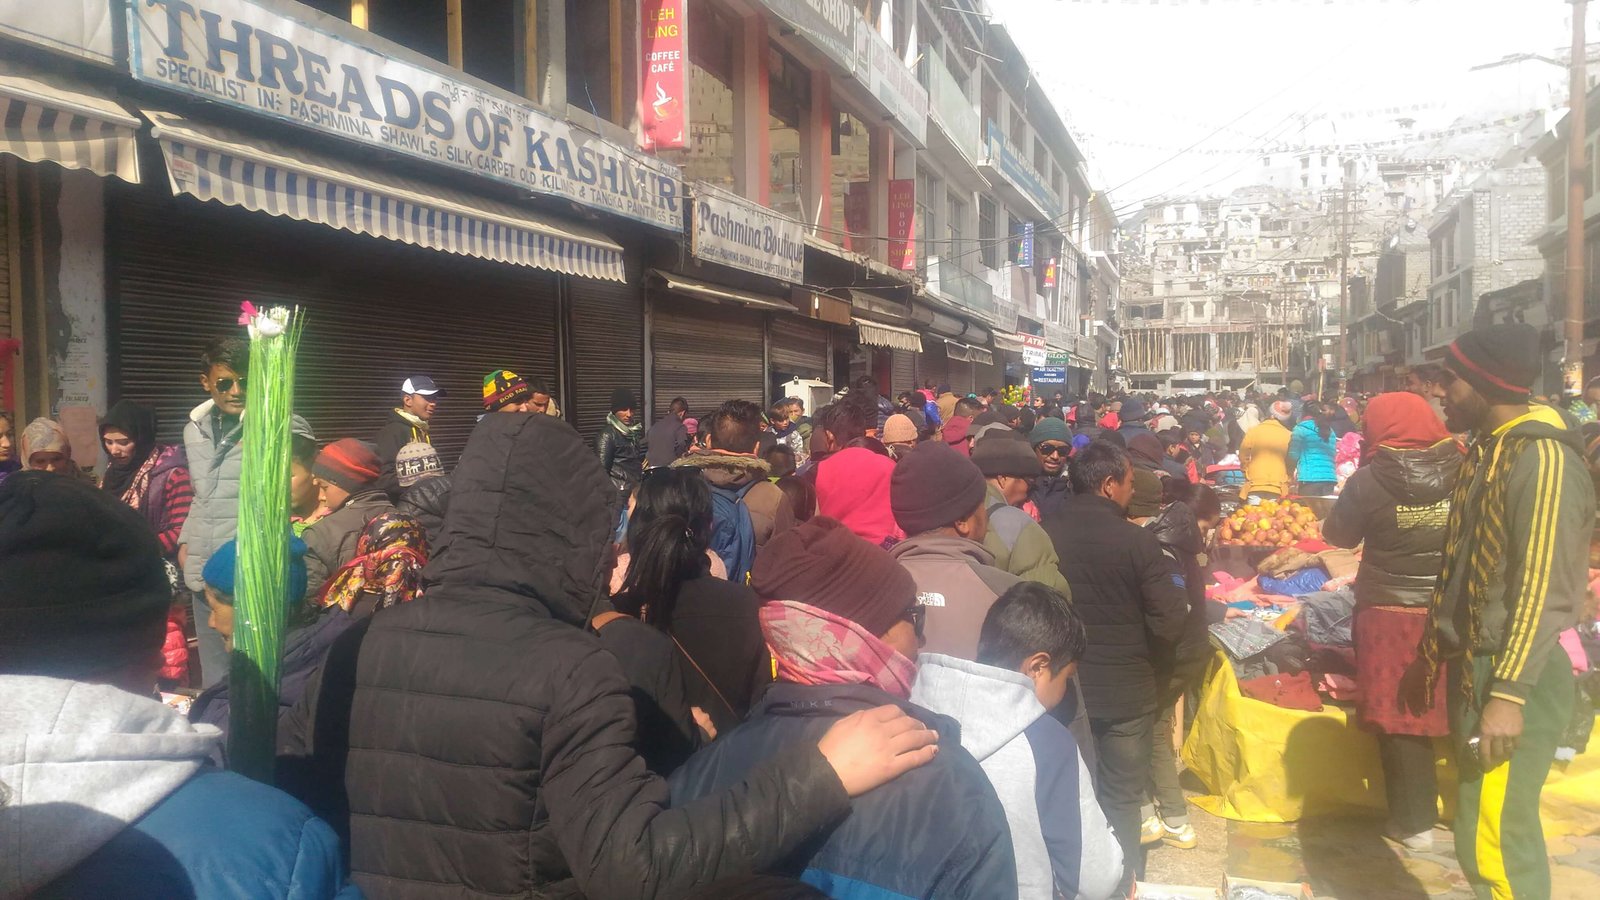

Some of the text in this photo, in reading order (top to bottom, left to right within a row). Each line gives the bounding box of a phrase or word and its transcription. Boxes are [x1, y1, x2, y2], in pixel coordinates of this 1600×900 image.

[651, 8, 675, 21] LEH
[648, 25, 678, 38] LING
[646, 51, 680, 61] COFFEE
[651, 61, 675, 73] CAFÉ
[146, 0, 454, 141] THREADS
[466, 108, 513, 158] OF
[523, 126, 677, 212] KASHMIR
[156, 58, 247, 101] SPECIALIST
[290, 97, 373, 138] PASHMINA
[446, 145, 472, 166] SILK
[520, 168, 536, 185] OLD
[579, 186, 586, 199] &
[627, 200, 666, 222] PAINTINGS
[699, 201, 761, 250] Pashmina
[890, 248, 912, 257] SHOP
[1026, 336, 1045, 347] ATM
[499, 392, 514, 403] BOB
[791, 699, 832, 709] NIKE
